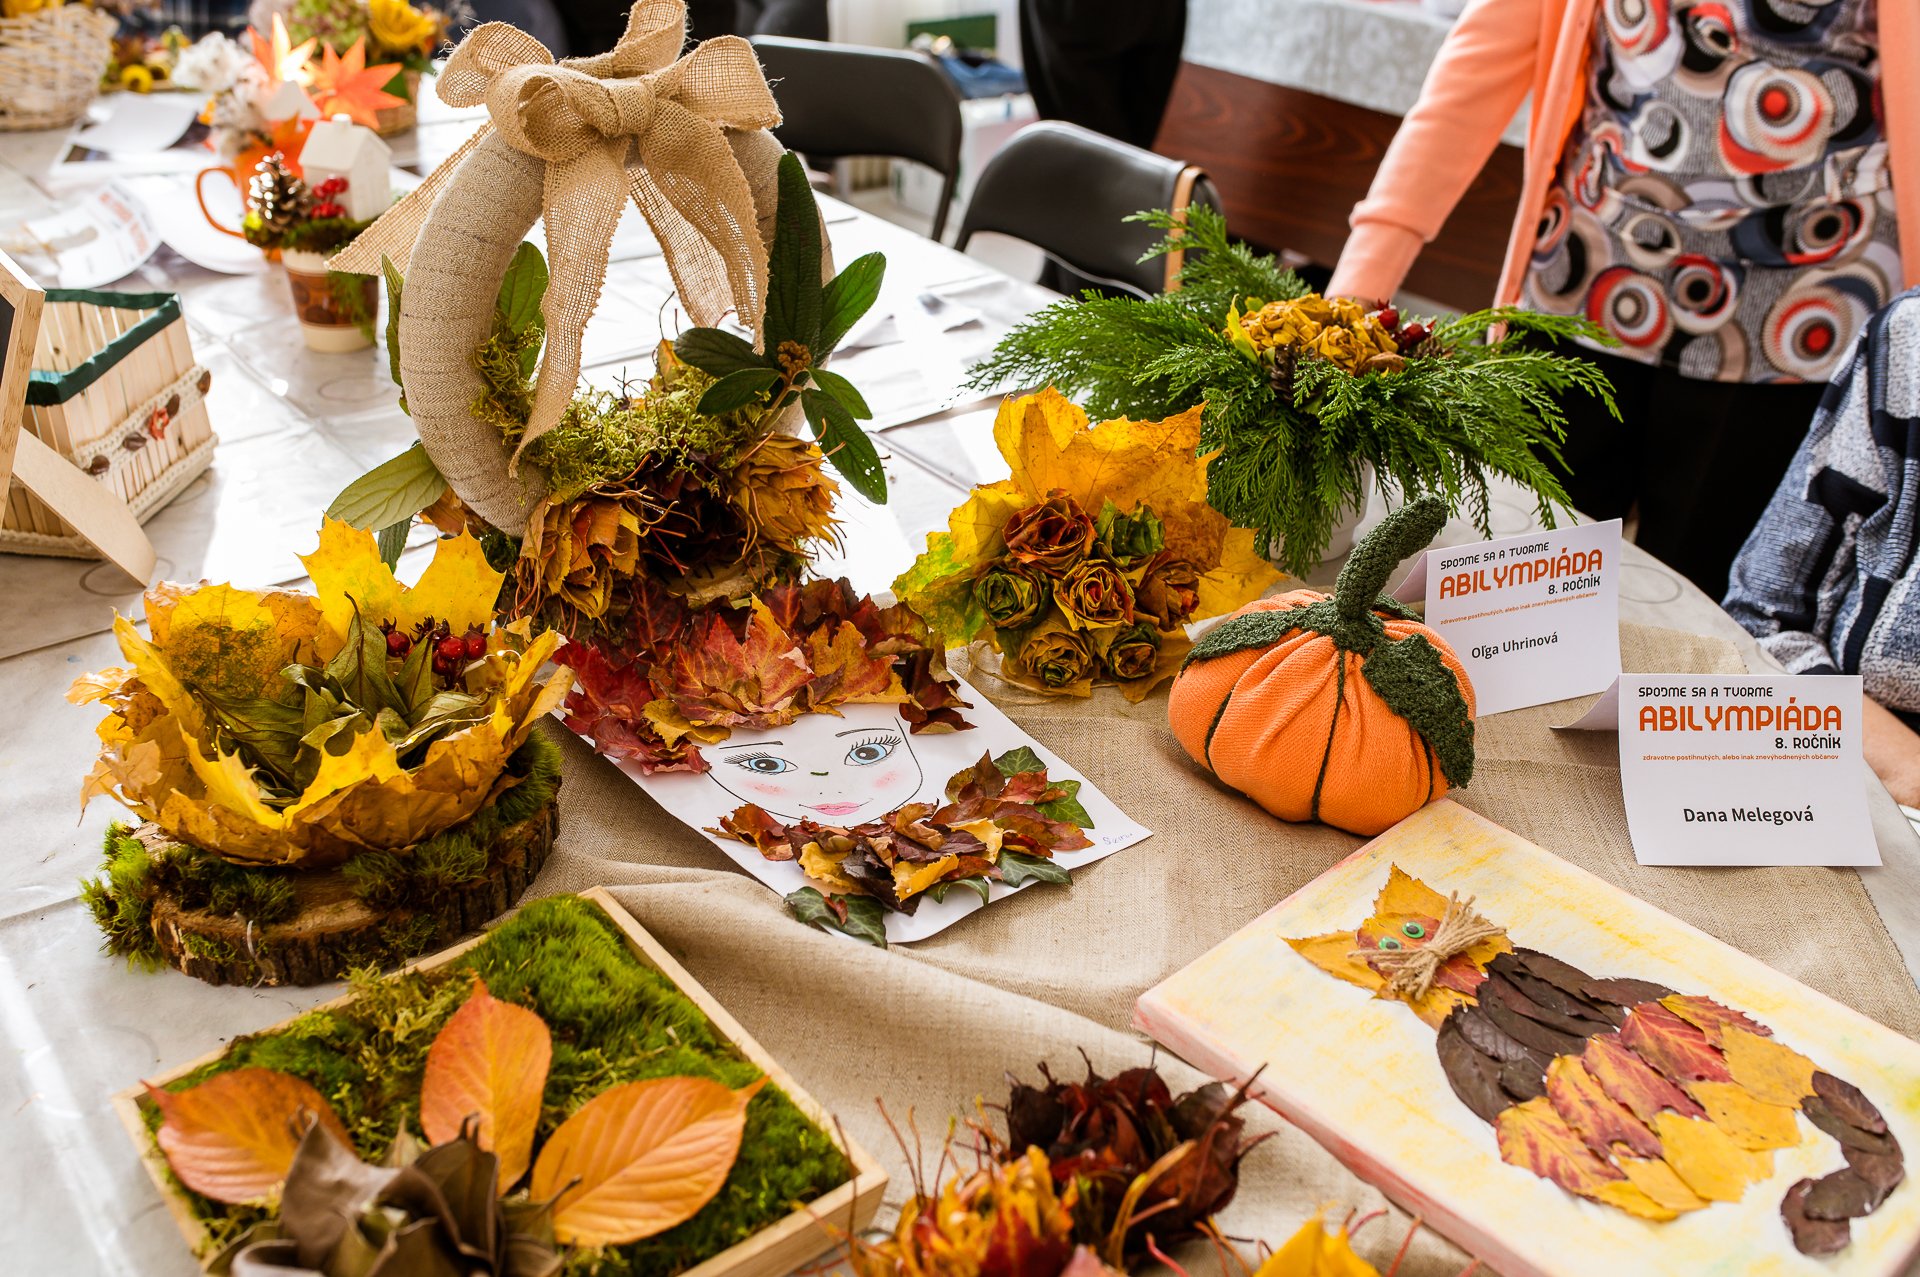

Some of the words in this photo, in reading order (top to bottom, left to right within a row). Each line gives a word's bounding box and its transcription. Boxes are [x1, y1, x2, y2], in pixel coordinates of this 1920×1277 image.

[1440, 554, 1480, 570] SPOJME
[1483, 551, 1496, 562] SA
[1498, 549, 1505, 559] A
[1509, 541, 1550, 557] TVORME
[1439, 547, 1603, 600] ABILYMPIÁDA
[1547, 584, 1558, 595] 8.
[1562, 573, 1601, 593] ROČNÍK
[1471, 644, 1499, 660] Oľga
[1502, 631, 1558, 653] Uhrinová
[1638, 687, 1687, 698] SPOJME
[1691, 687, 1707, 698] SA
[1711, 687, 1719, 697] A
[1723, 687, 1773, 697] TVORME
[1639, 697, 1842, 731] ABILYMPIÁDA
[1774, 737, 1788, 749] 8.
[1793, 733, 1841, 749] ROČNÍK
[1676, 753, 1721, 762] postihnutých,
[1755, 753, 1811, 762] znevýhodnených
[1811, 753, 1839, 761] občanov
[1683, 807, 1728, 823] Dana
[1731, 804, 1814, 826] Melegová
